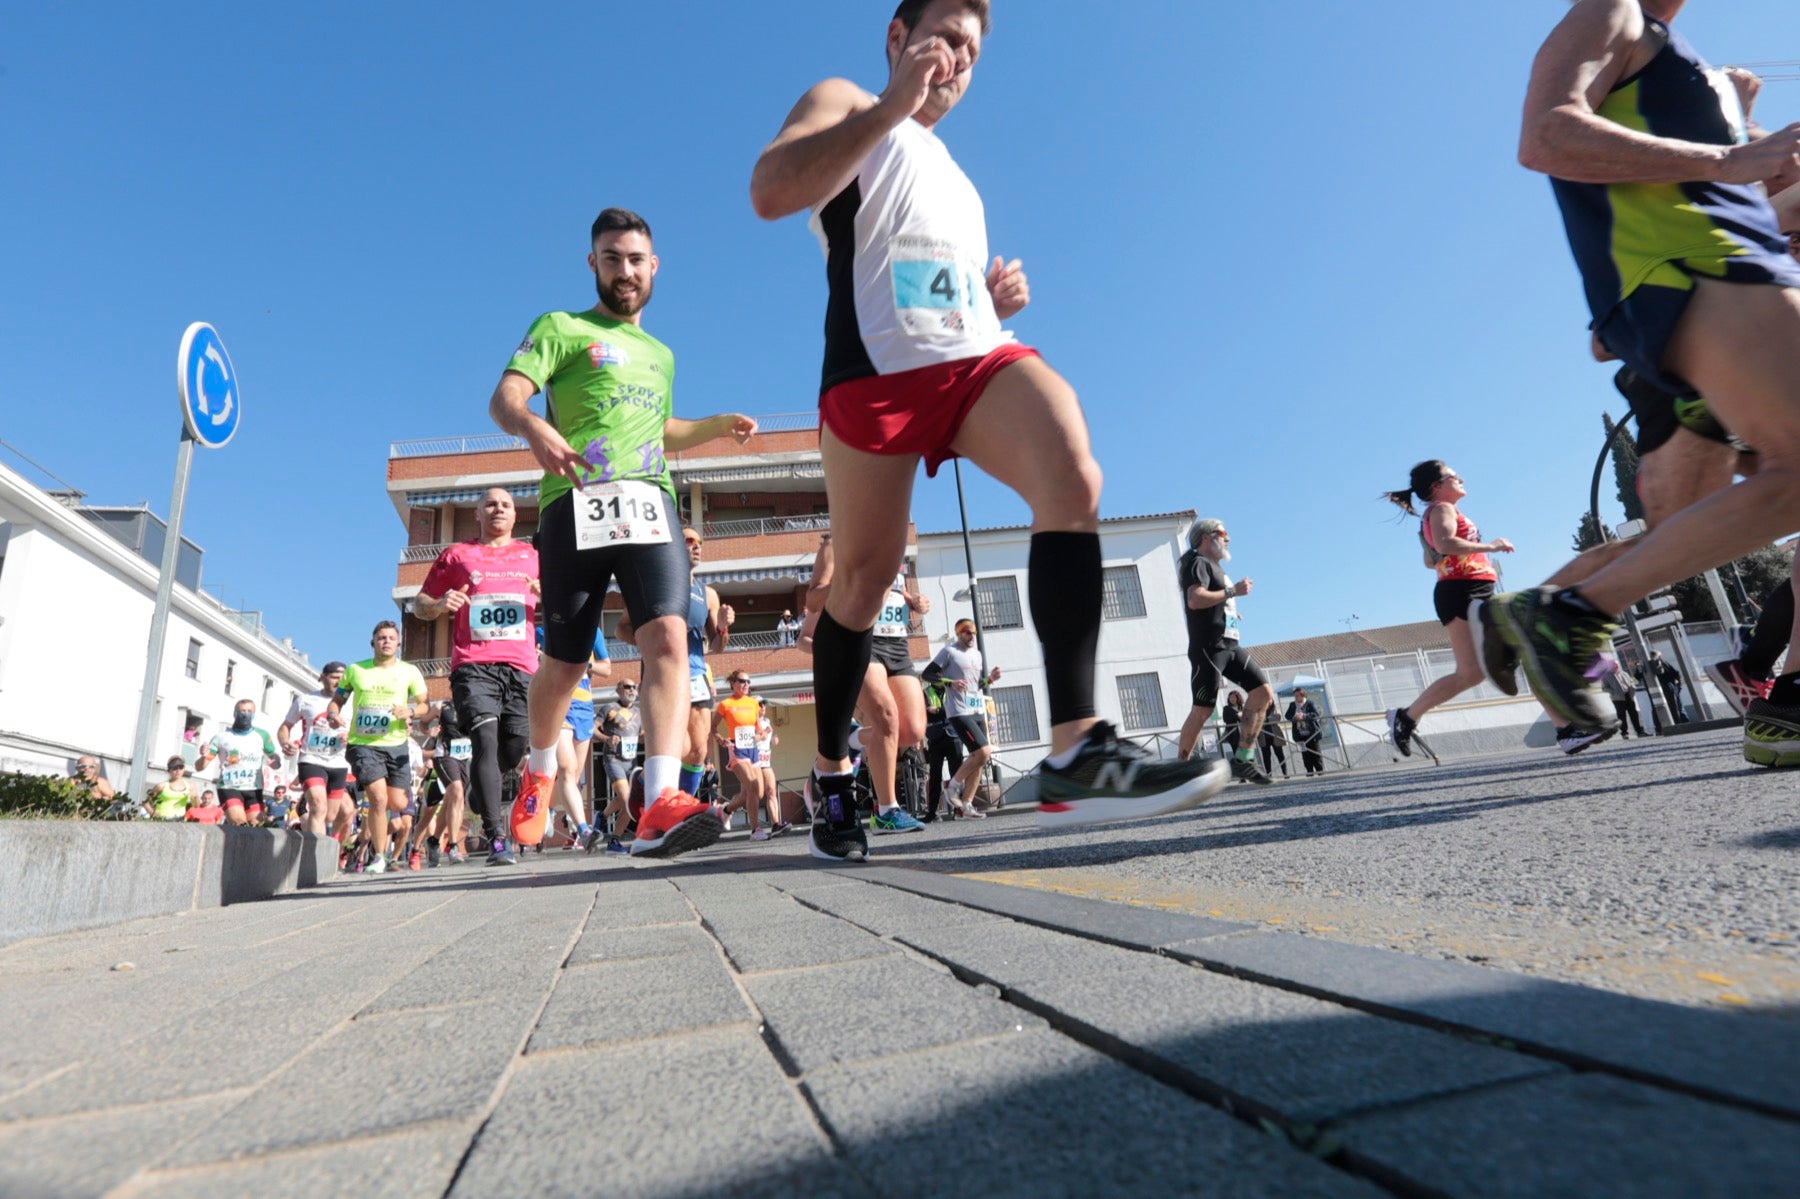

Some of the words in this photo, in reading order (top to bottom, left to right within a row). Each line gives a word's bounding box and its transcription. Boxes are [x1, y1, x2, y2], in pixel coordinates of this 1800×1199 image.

[587, 496, 658, 522] 3118
[480, 608, 518, 625] 809
[357, 715, 389, 727] 1070
[314, 735, 336, 747] 148
[224, 769, 254, 781] 1142
[1091, 761, 1142, 792] N
